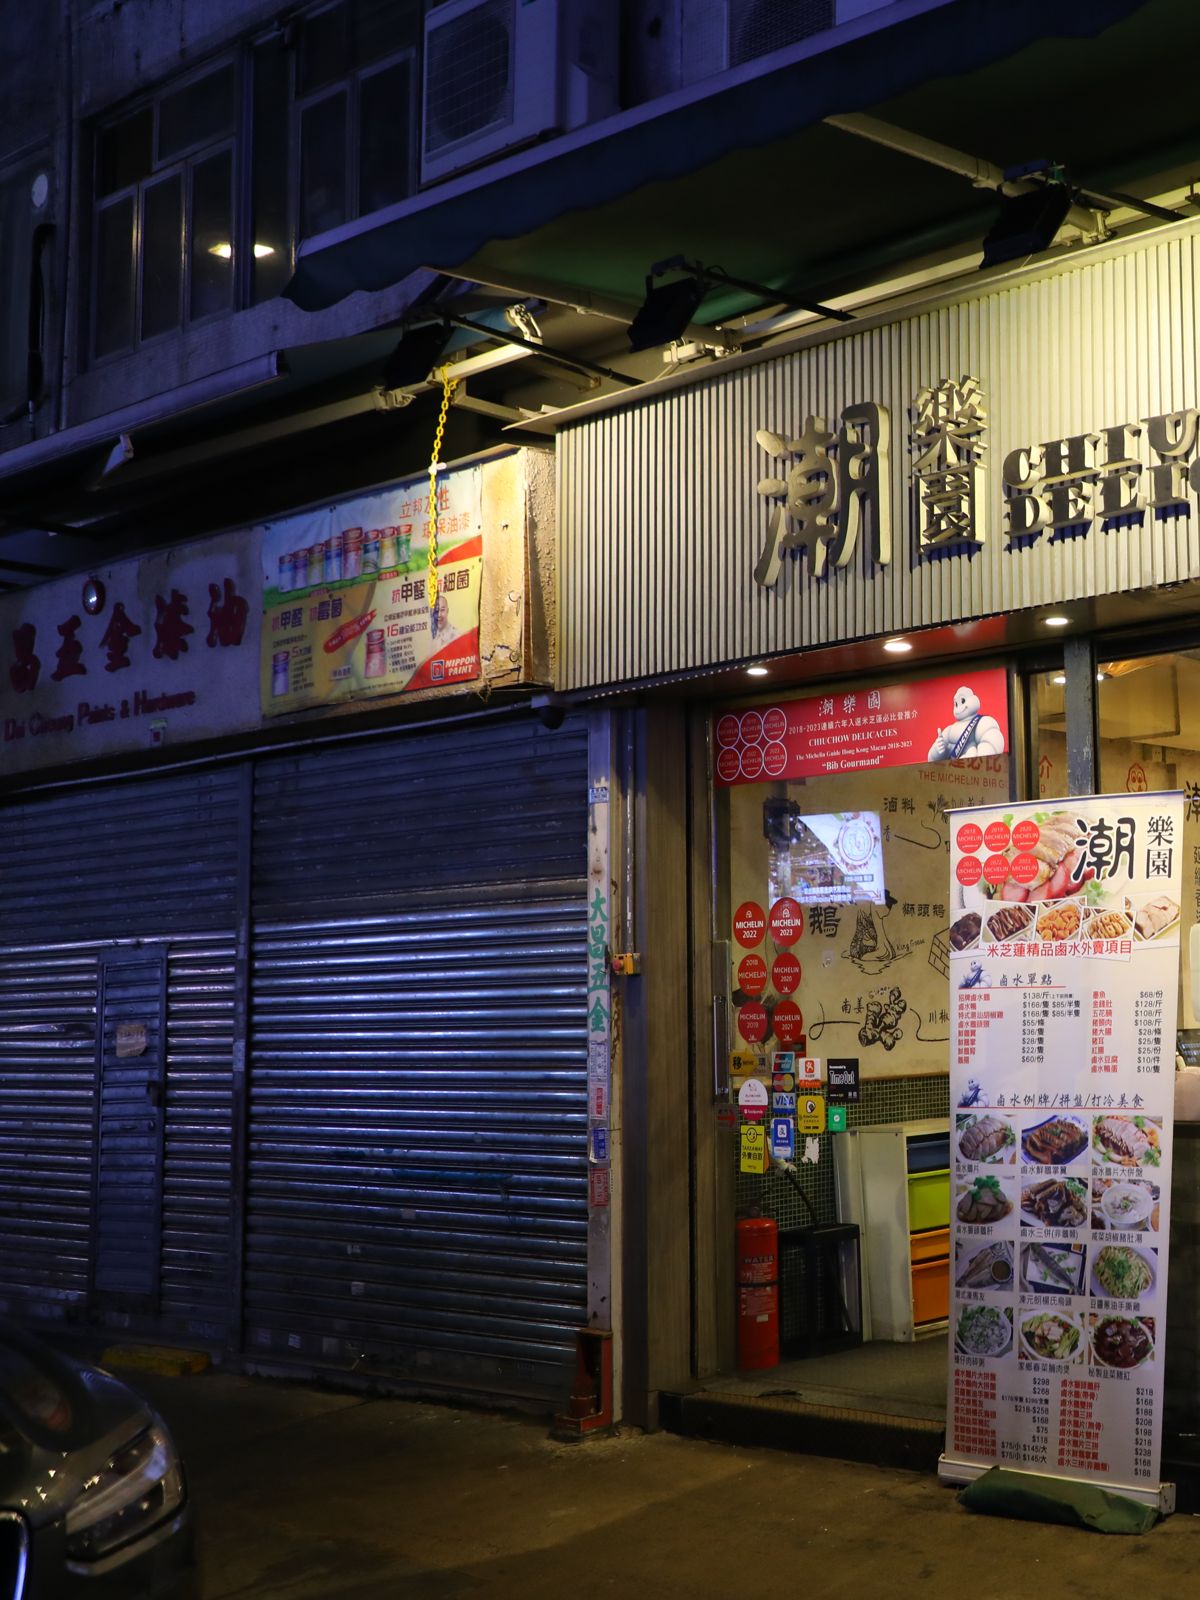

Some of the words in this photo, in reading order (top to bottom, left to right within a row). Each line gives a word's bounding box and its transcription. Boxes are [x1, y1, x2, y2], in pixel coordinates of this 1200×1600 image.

[445, 655, 476, 668] NIPPON
[448, 664, 473, 676] PAINT
[808, 734, 850, 747] CHIUCHOW
[851, 728, 898, 742] DELICACIES
[937, 772, 980, 786] MICHELIN
[1071, 815, 1175, 883] 潮樂園
[735, 921, 763, 929] MICHELIN
[771, 919, 801, 927] MICHELIN
[742, 930, 757, 938] 2022
[587, 887, 609, 1034] 大昌五金
[738, 971, 767, 979] MICHELIN
[739, 1013, 766, 1021] MICHELIN
[775, 1095, 794, 1106] VISA
[1032, 1377, 1050, 1386] $298
